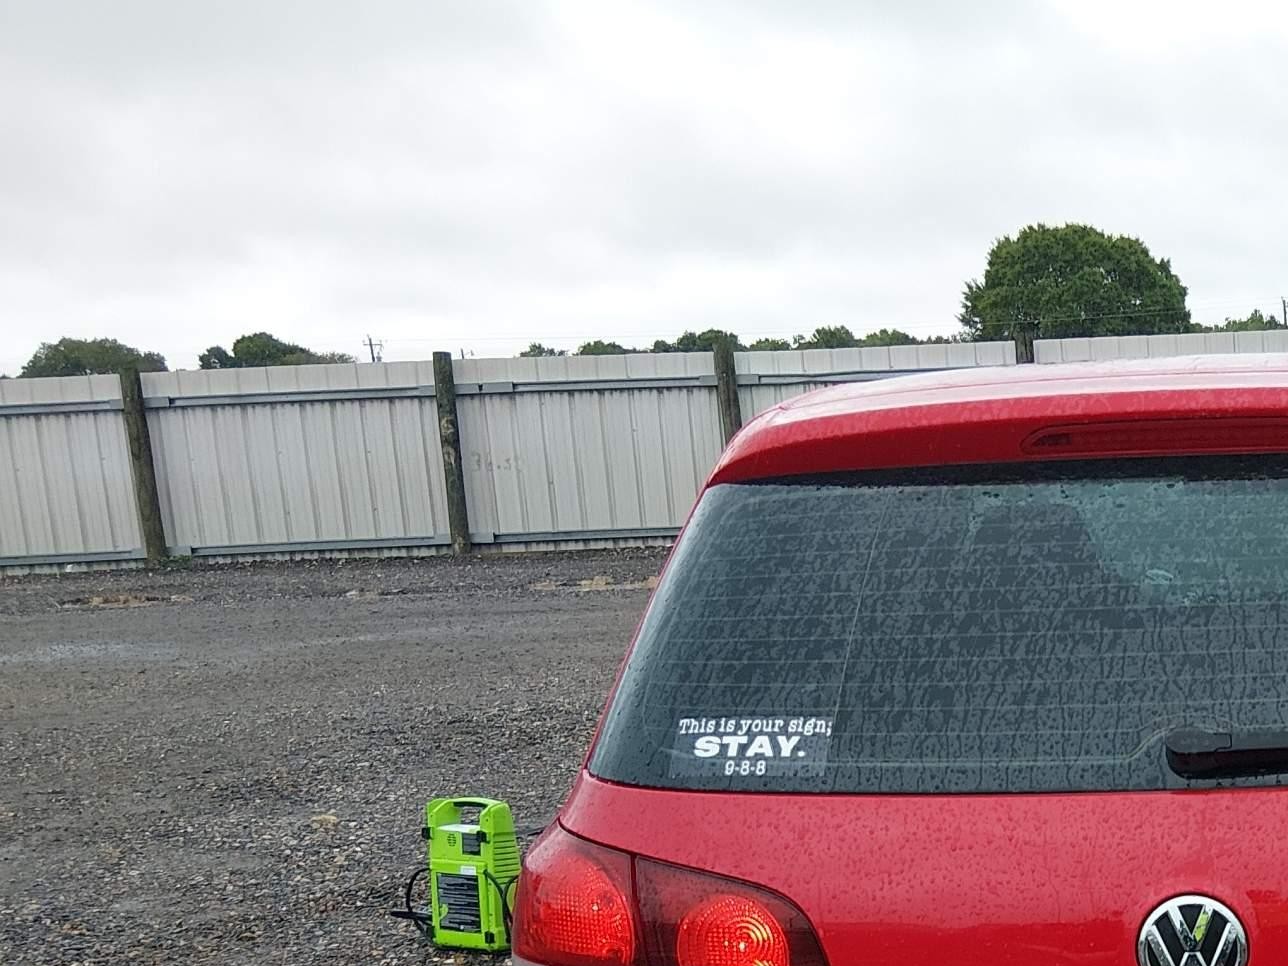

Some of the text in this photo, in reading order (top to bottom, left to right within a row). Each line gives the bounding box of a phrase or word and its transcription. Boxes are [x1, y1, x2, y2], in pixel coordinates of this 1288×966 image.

[679, 716, 833, 737] This is your sign;
[693, 735, 806, 757] STAY.
[724, 760, 767, 776] 9-8-8
